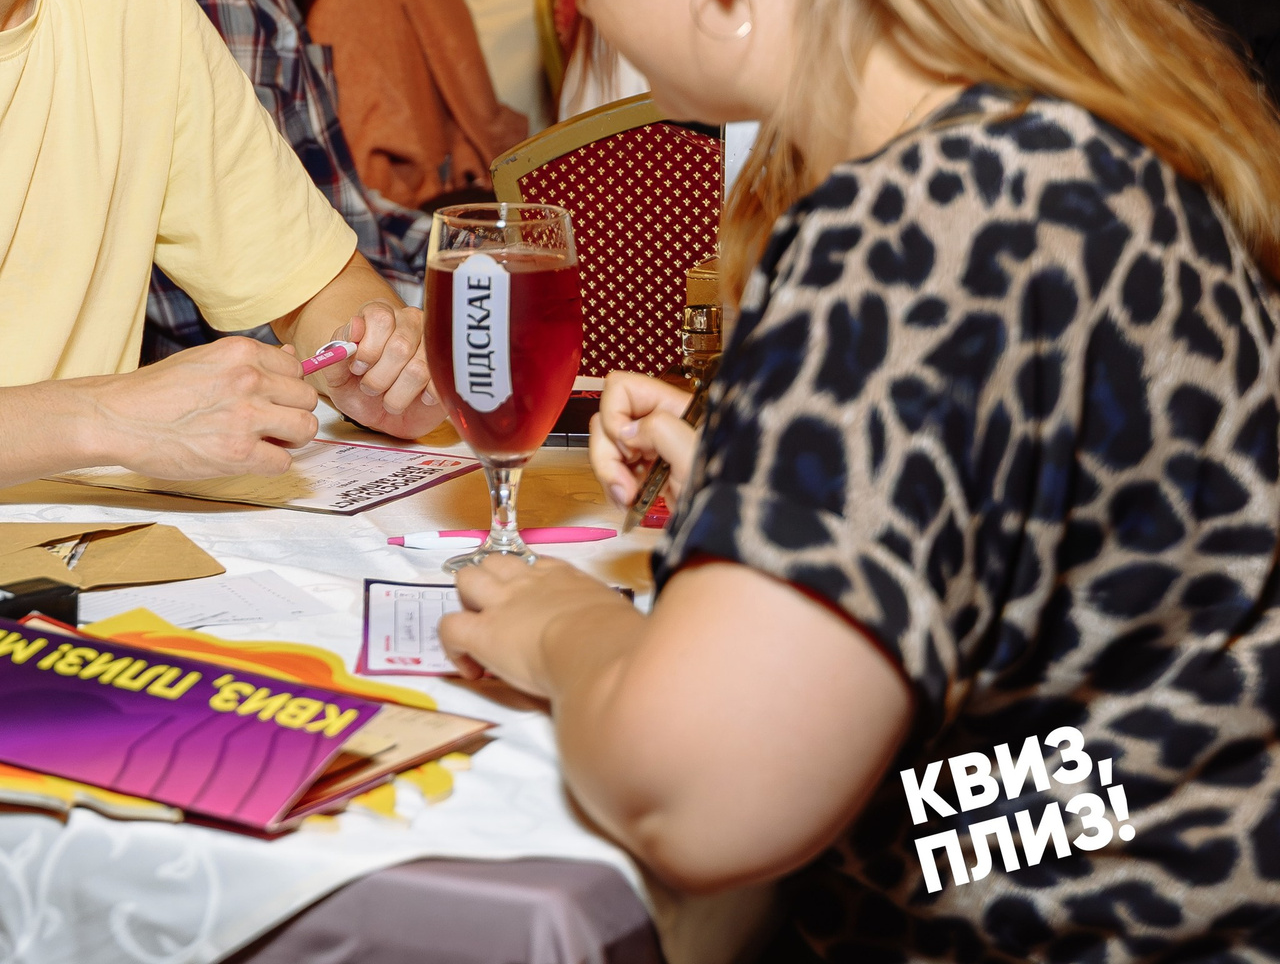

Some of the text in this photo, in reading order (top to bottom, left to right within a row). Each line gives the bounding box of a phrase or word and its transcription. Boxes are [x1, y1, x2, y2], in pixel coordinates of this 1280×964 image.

[467, 276, 495, 398] ЛІДСКАЕ
[35, 642, 204, 700] ПЛИЗ!
[209, 673, 359, 737] КВИЗ,
